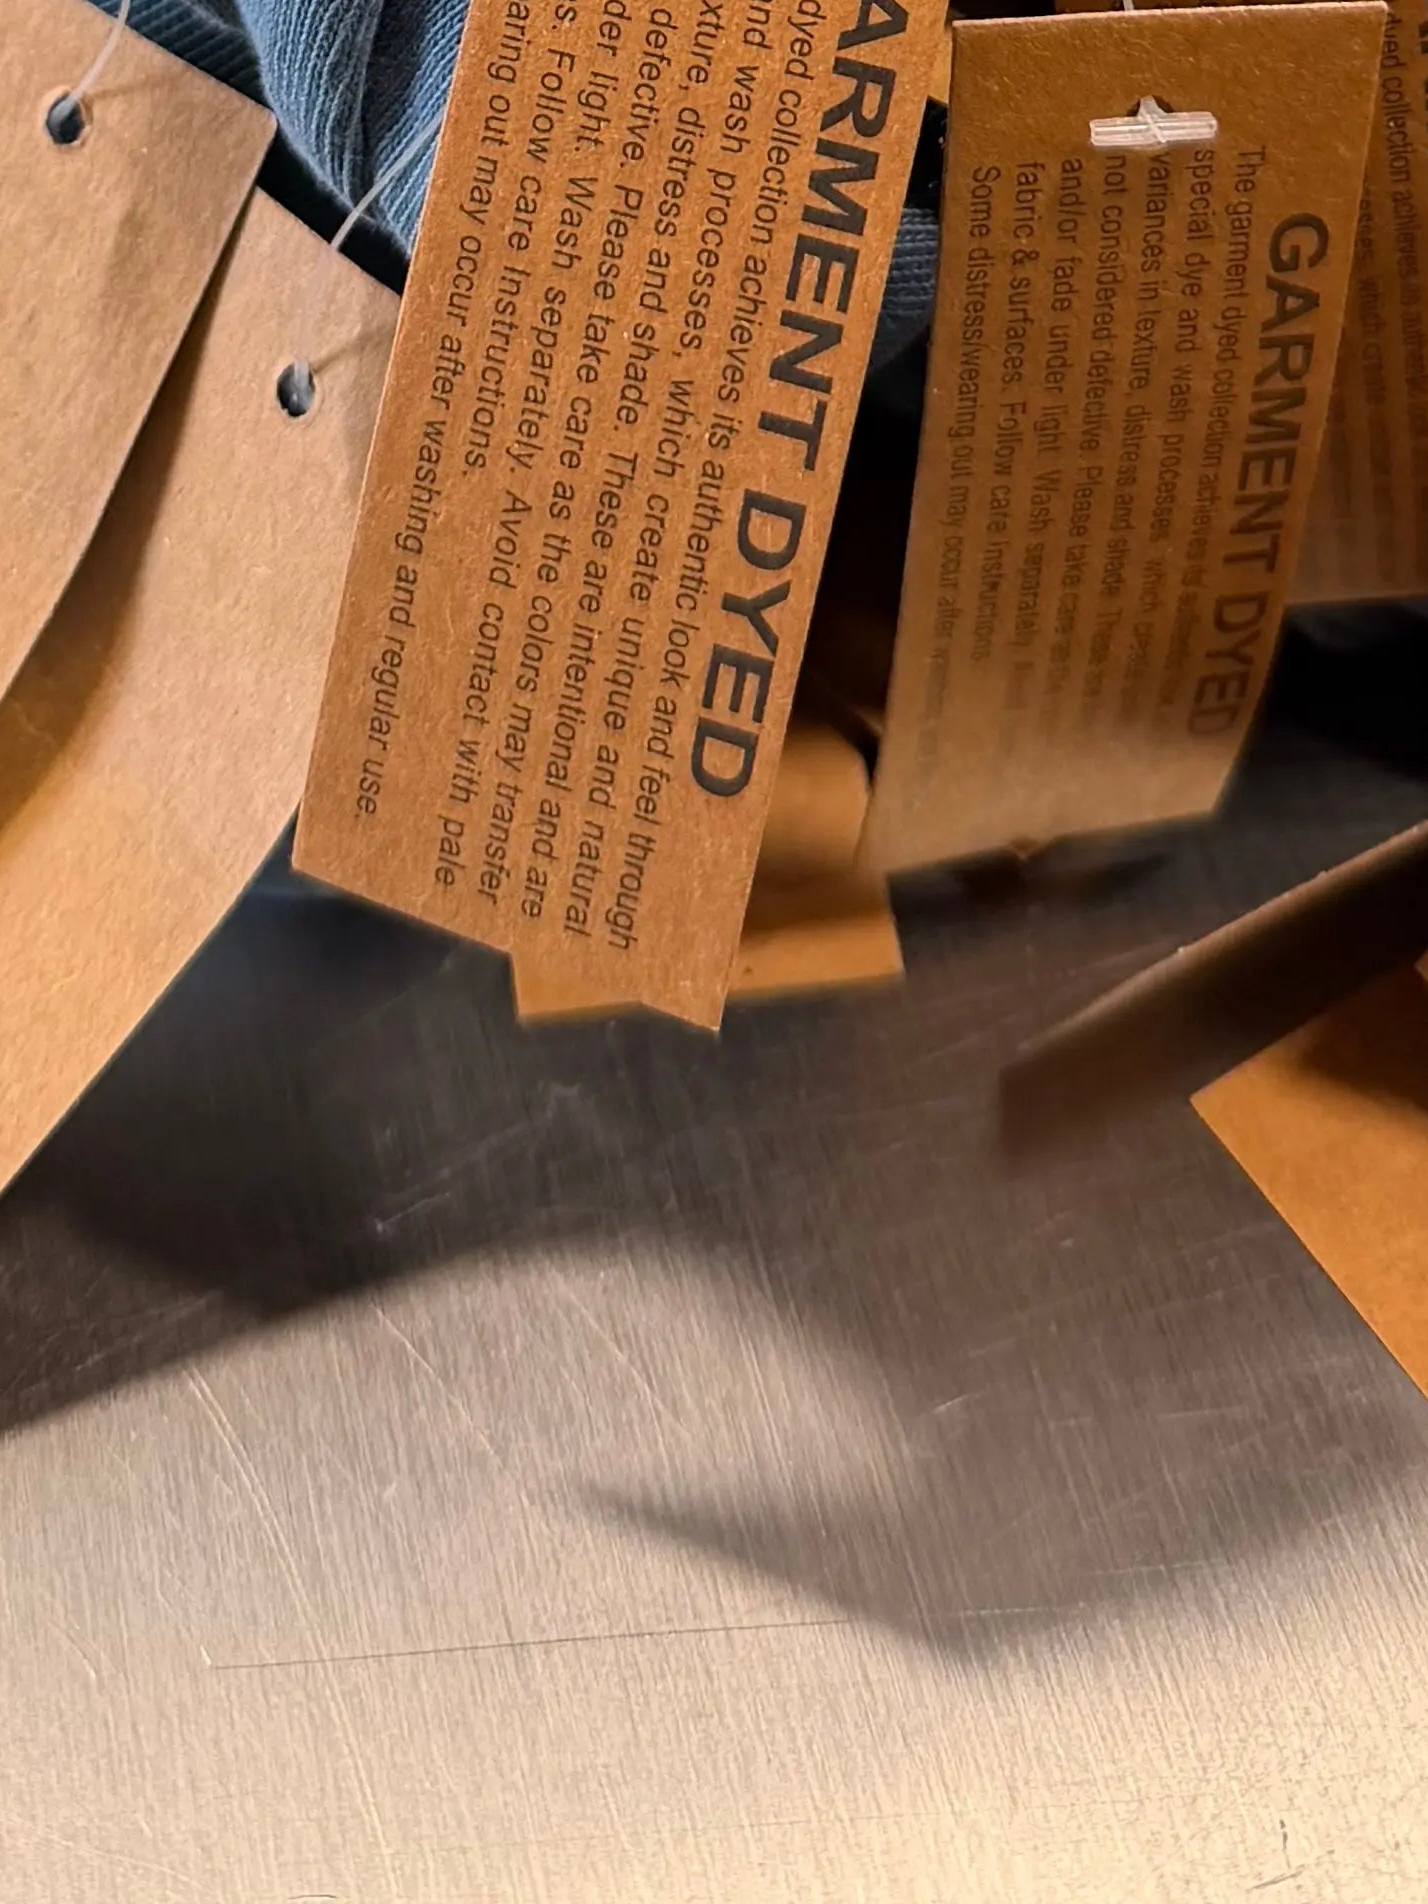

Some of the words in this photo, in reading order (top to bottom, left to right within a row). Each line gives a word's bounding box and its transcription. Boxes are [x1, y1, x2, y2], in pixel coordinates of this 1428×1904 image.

[478, 92, 511, 147] out
[524, 46, 577, 165] Follow
[572, 69, 620, 152] light.
[618, 7, 680, 169] defective.
[718, 64, 760, 154] wash
[457, 154, 499, 226] may
[652, 105, 707, 238] distress
[748, 87, 803, 245] collection
[966, 164, 1002, 241] Some
[1010, 159, 1047, 240] fabric
[1054, 156, 1088, 245] and/or
[1100, 153, 1131, 198] not
[1182, 144, 1217, 242] special
[1232, 143, 1268, 194] The
[506, 173, 543, 253] care
[549, 175, 599, 270] Wash
[591, 182, 645, 301] Please
[1139, 151, 1179, 274] variances
[1221, 199, 1254, 300] garment
[444, 233, 482, 328] occur
[637, 246, 671, 315] and
[669, 166, 738, 359] processes,
[1009, 247, 1041, 268] &
[1045, 254, 1084, 313] fade
[1089, 203, 1127, 345] considered
[1134, 279, 1168, 302] in
[1174, 250, 1212, 299] dye
[574, 311, 616, 385] take
[715, 253, 768, 404] achieves
[945, 245, 997, 441] distress/wearing
[1042, 323, 1074, 395] under
[1172, 307, 1204, 354] and
[1210, 304, 1248, 364] dyed
[428, 332, 467, 411] after
[460, 264, 532, 478] Instructions.
[503, 284, 567, 474] separately.
[611, 321, 661, 432] shade.
[1164, 362, 1194, 424] wash
[1221, 211, 1331, 575] GARMENT
[557, 394, 593, 470] care
[651, 378, 696, 479] which
[706, 411, 744, 451] its
[991, 400, 1028, 478] Follow
[392, 419, 448, 556] washing
[547, 479, 576, 521] as
[589, 450, 640, 551] These
[1026, 468, 1062, 535] Wash
[1066, 464, 1104, 539] Please
[1107, 492, 1136, 532] and
[486, 488, 533, 590] Avoid
[535, 531, 572, 585] the
[627, 491, 670, 606] create
[673, 458, 726, 612] authentic
[386, 563, 419, 629] and
[576, 558, 608, 616] are
[460, 601, 504, 728] contact
[513, 594, 555, 693] colors
[601, 615, 646, 734] unique
[657, 617, 701, 691] look
[689, 487, 807, 799] DYED
[1186, 589, 1271, 735] DYED
[366, 633, 406, 752] regular
[543, 621, 603, 793] intentional
[645, 694, 678, 760] and
[446, 738, 482, 804] with
[493, 701, 533, 774] may
[586, 743, 620, 811] and
[352, 756, 385, 821] use.
[631, 763, 672, 826] feel
[433, 813, 466, 894] pale
[475, 780, 524, 907] transfer
[529, 797, 562, 864] and
[519, 864, 548, 920] are
[561, 819, 605, 938] natural
[603, 830, 657, 951] through
